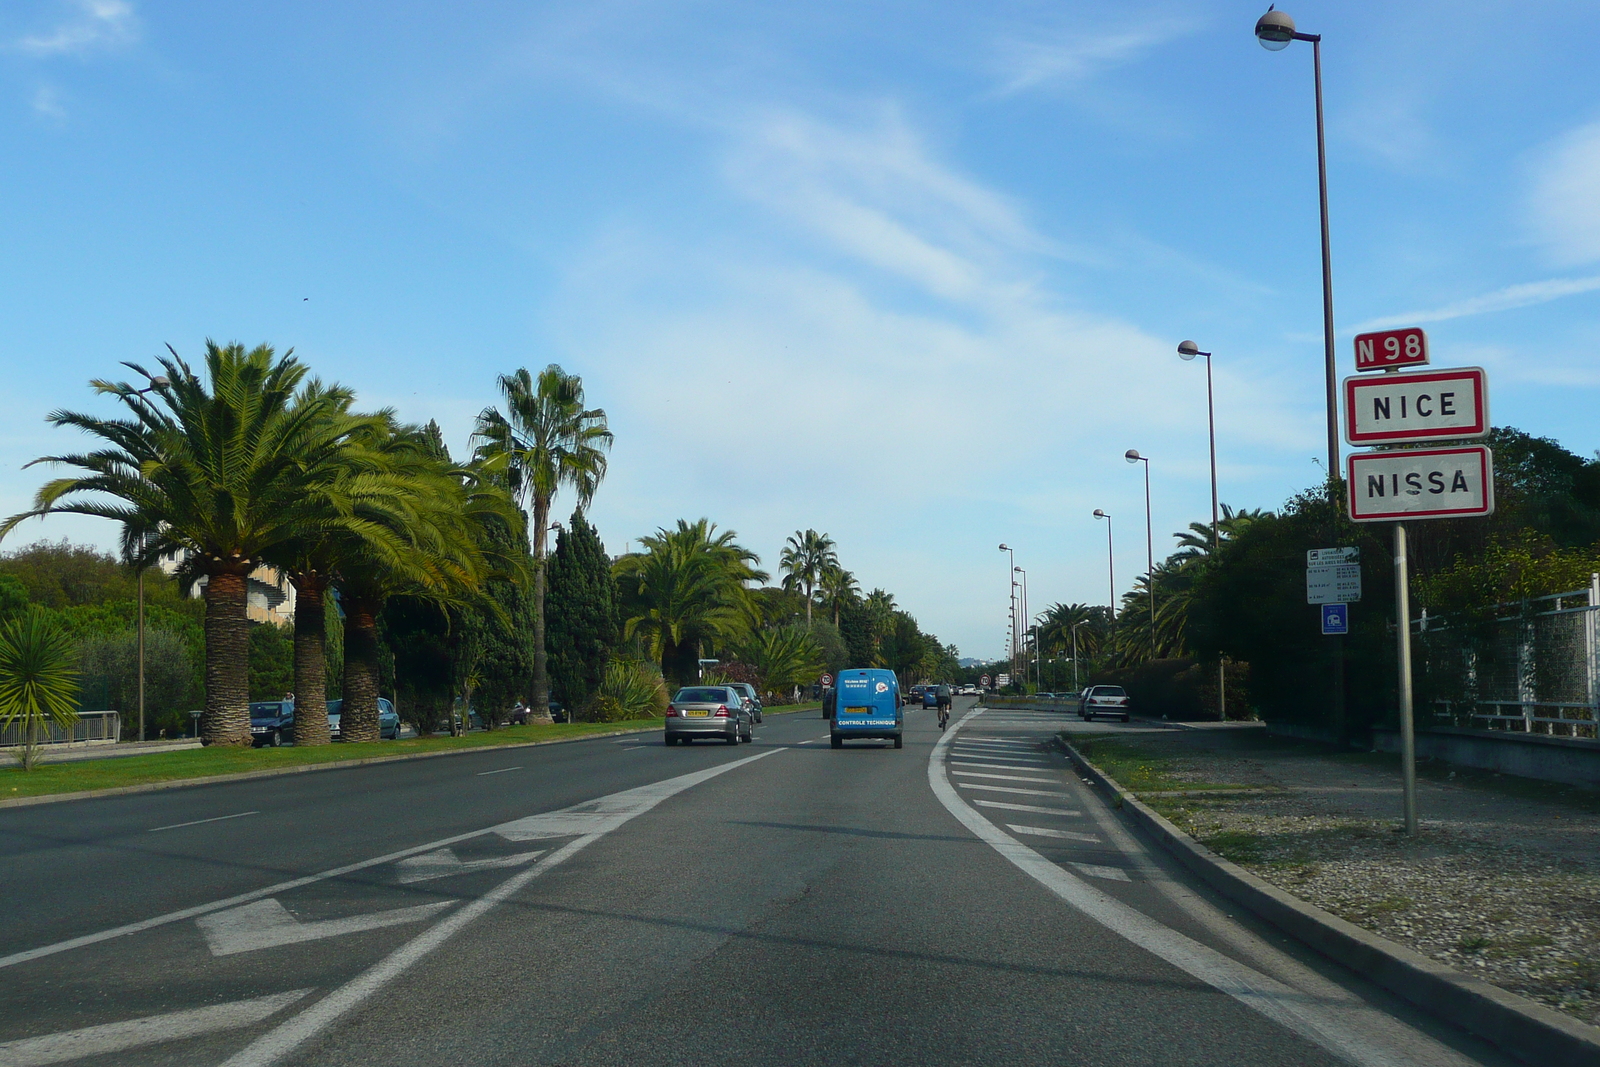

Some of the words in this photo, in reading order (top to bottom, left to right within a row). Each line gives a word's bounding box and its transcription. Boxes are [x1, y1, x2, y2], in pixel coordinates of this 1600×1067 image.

[1358, 339, 1375, 363] N
[1384, 334, 1421, 361] 98
[1373, 392, 1456, 420] NICE
[1368, 469, 1468, 498] NISSA
